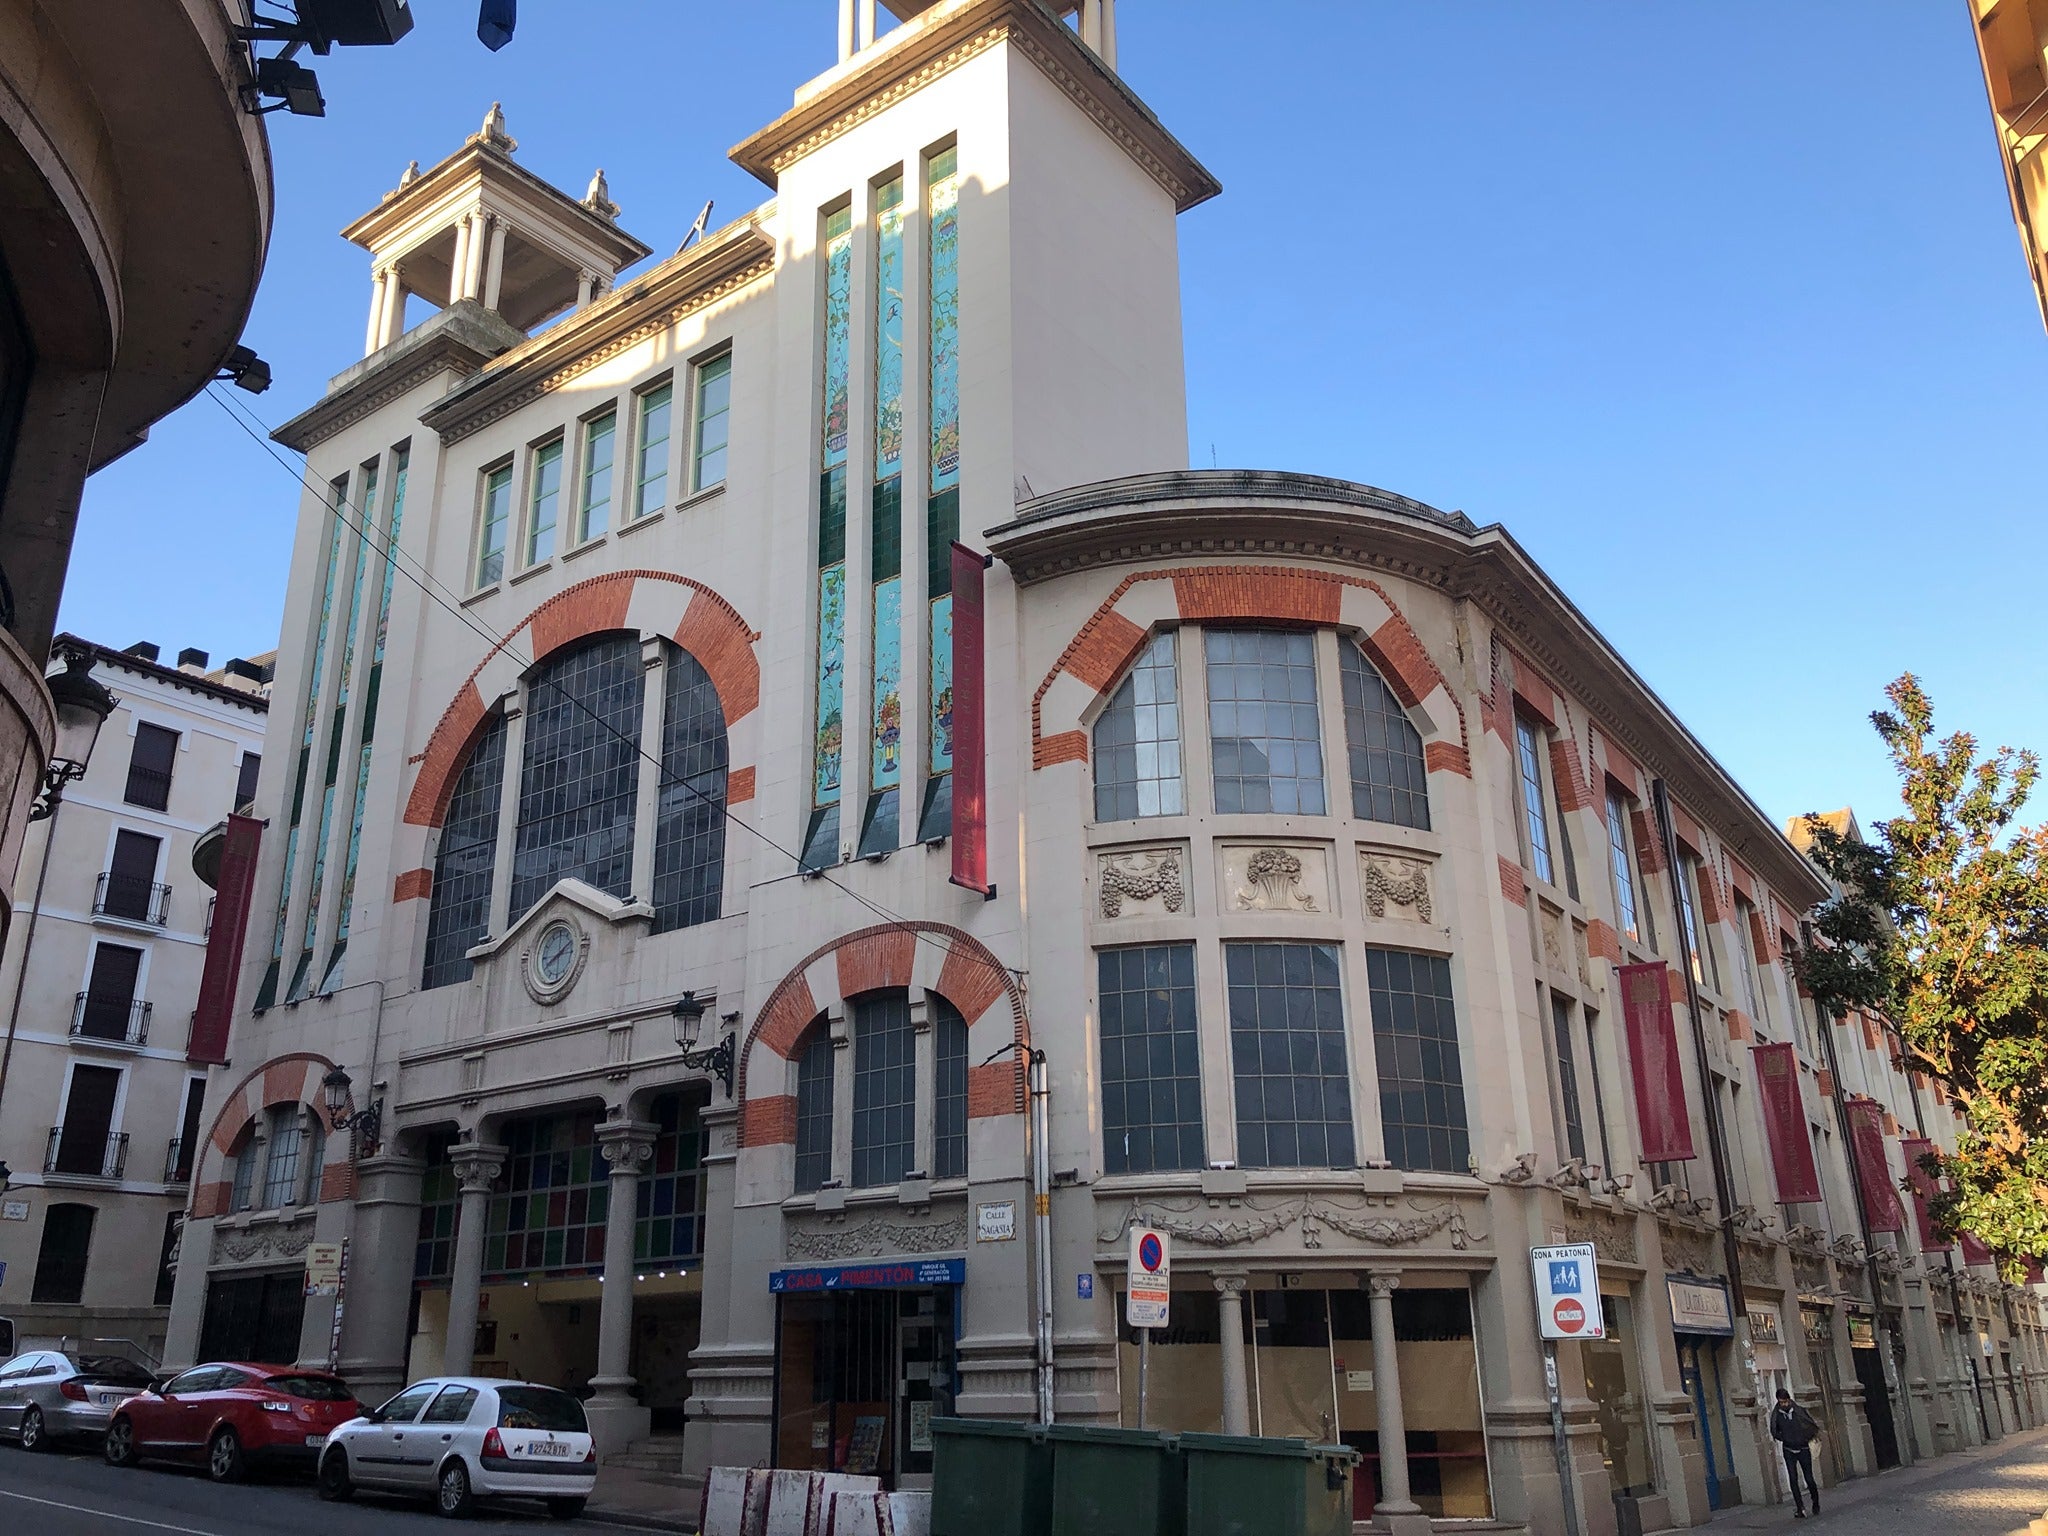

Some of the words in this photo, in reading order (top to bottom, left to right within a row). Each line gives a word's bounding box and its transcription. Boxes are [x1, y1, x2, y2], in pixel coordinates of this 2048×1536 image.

[985, 1211, 1006, 1220] CALLE
[981, 1223, 1011, 1235] SAGASTA
[1533, 1251, 1552, 1260] ZONA
[1555, 1248, 1591, 1258] PEATONAL
[786, 1273, 823, 1289] CASA
[841, 1265, 915, 1286] PIMENTÓN
